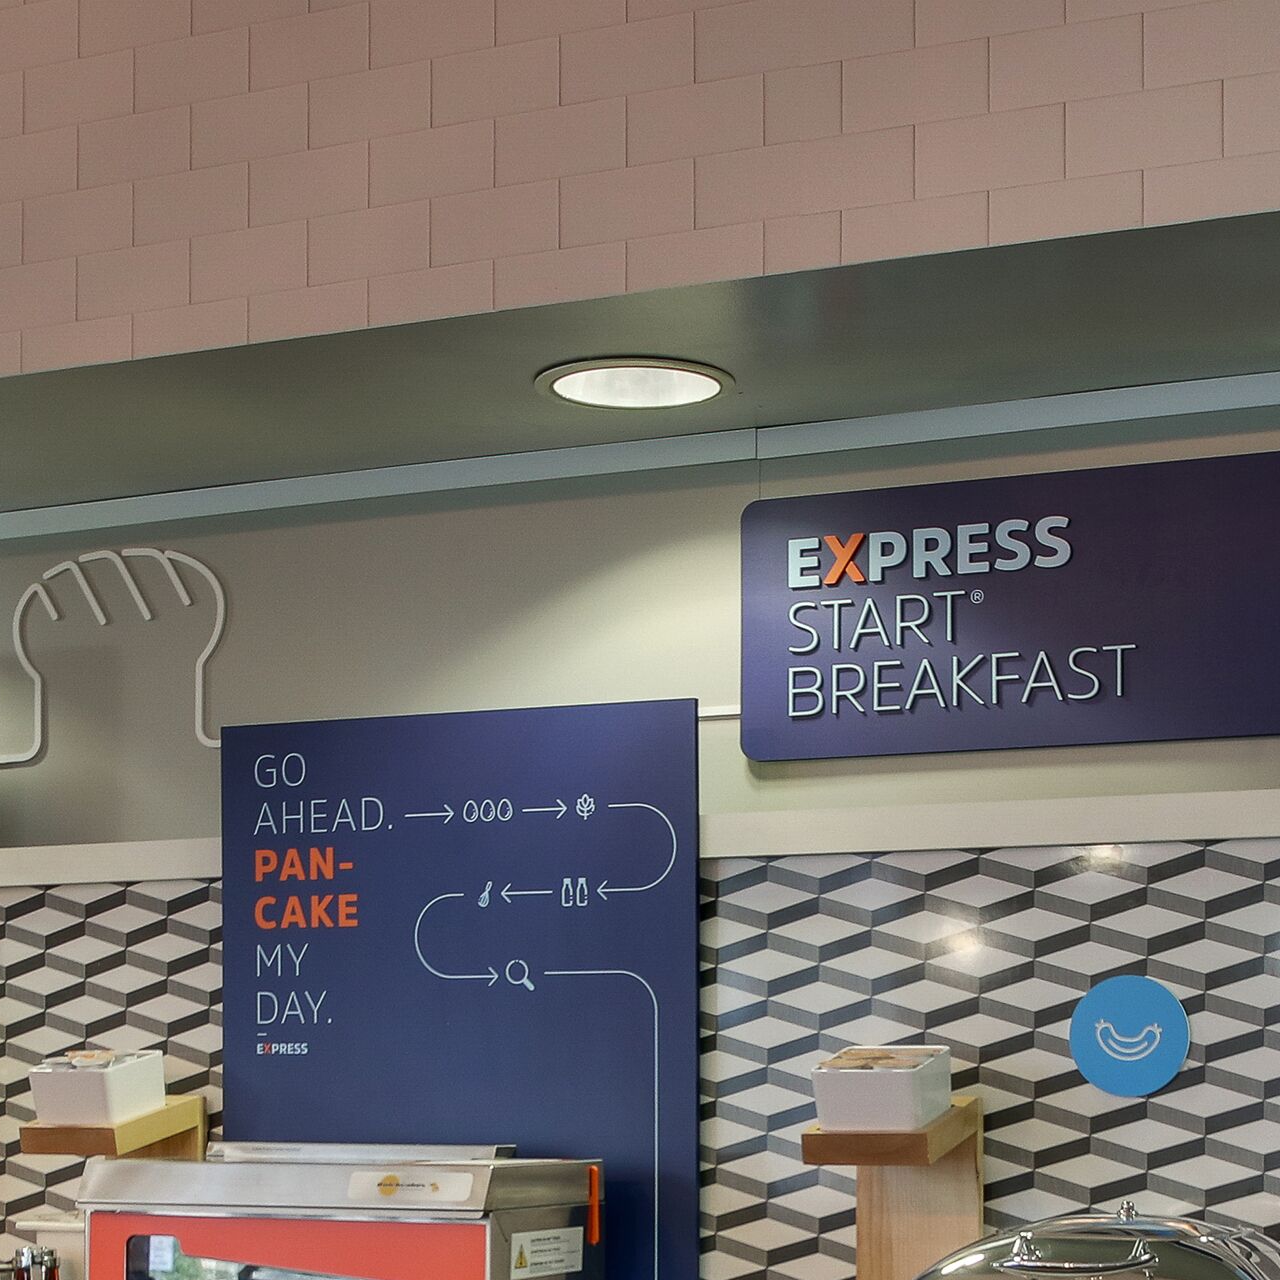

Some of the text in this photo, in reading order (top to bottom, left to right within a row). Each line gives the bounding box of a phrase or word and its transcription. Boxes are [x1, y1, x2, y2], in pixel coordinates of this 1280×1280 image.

[786, 515, 1072, 589] EXPRESS
[787, 643, 1137, 717] BREAKFAST
[254, 752, 308, 788] GO
[253, 797, 394, 836] AHEAD.
[254, 847, 354, 882] PAN-
[253, 894, 359, 930] CAKE
[256, 942, 309, 978] MY
[256, 990, 333, 1026] DAY.
[256, 1042, 309, 1056] EXPRESS
